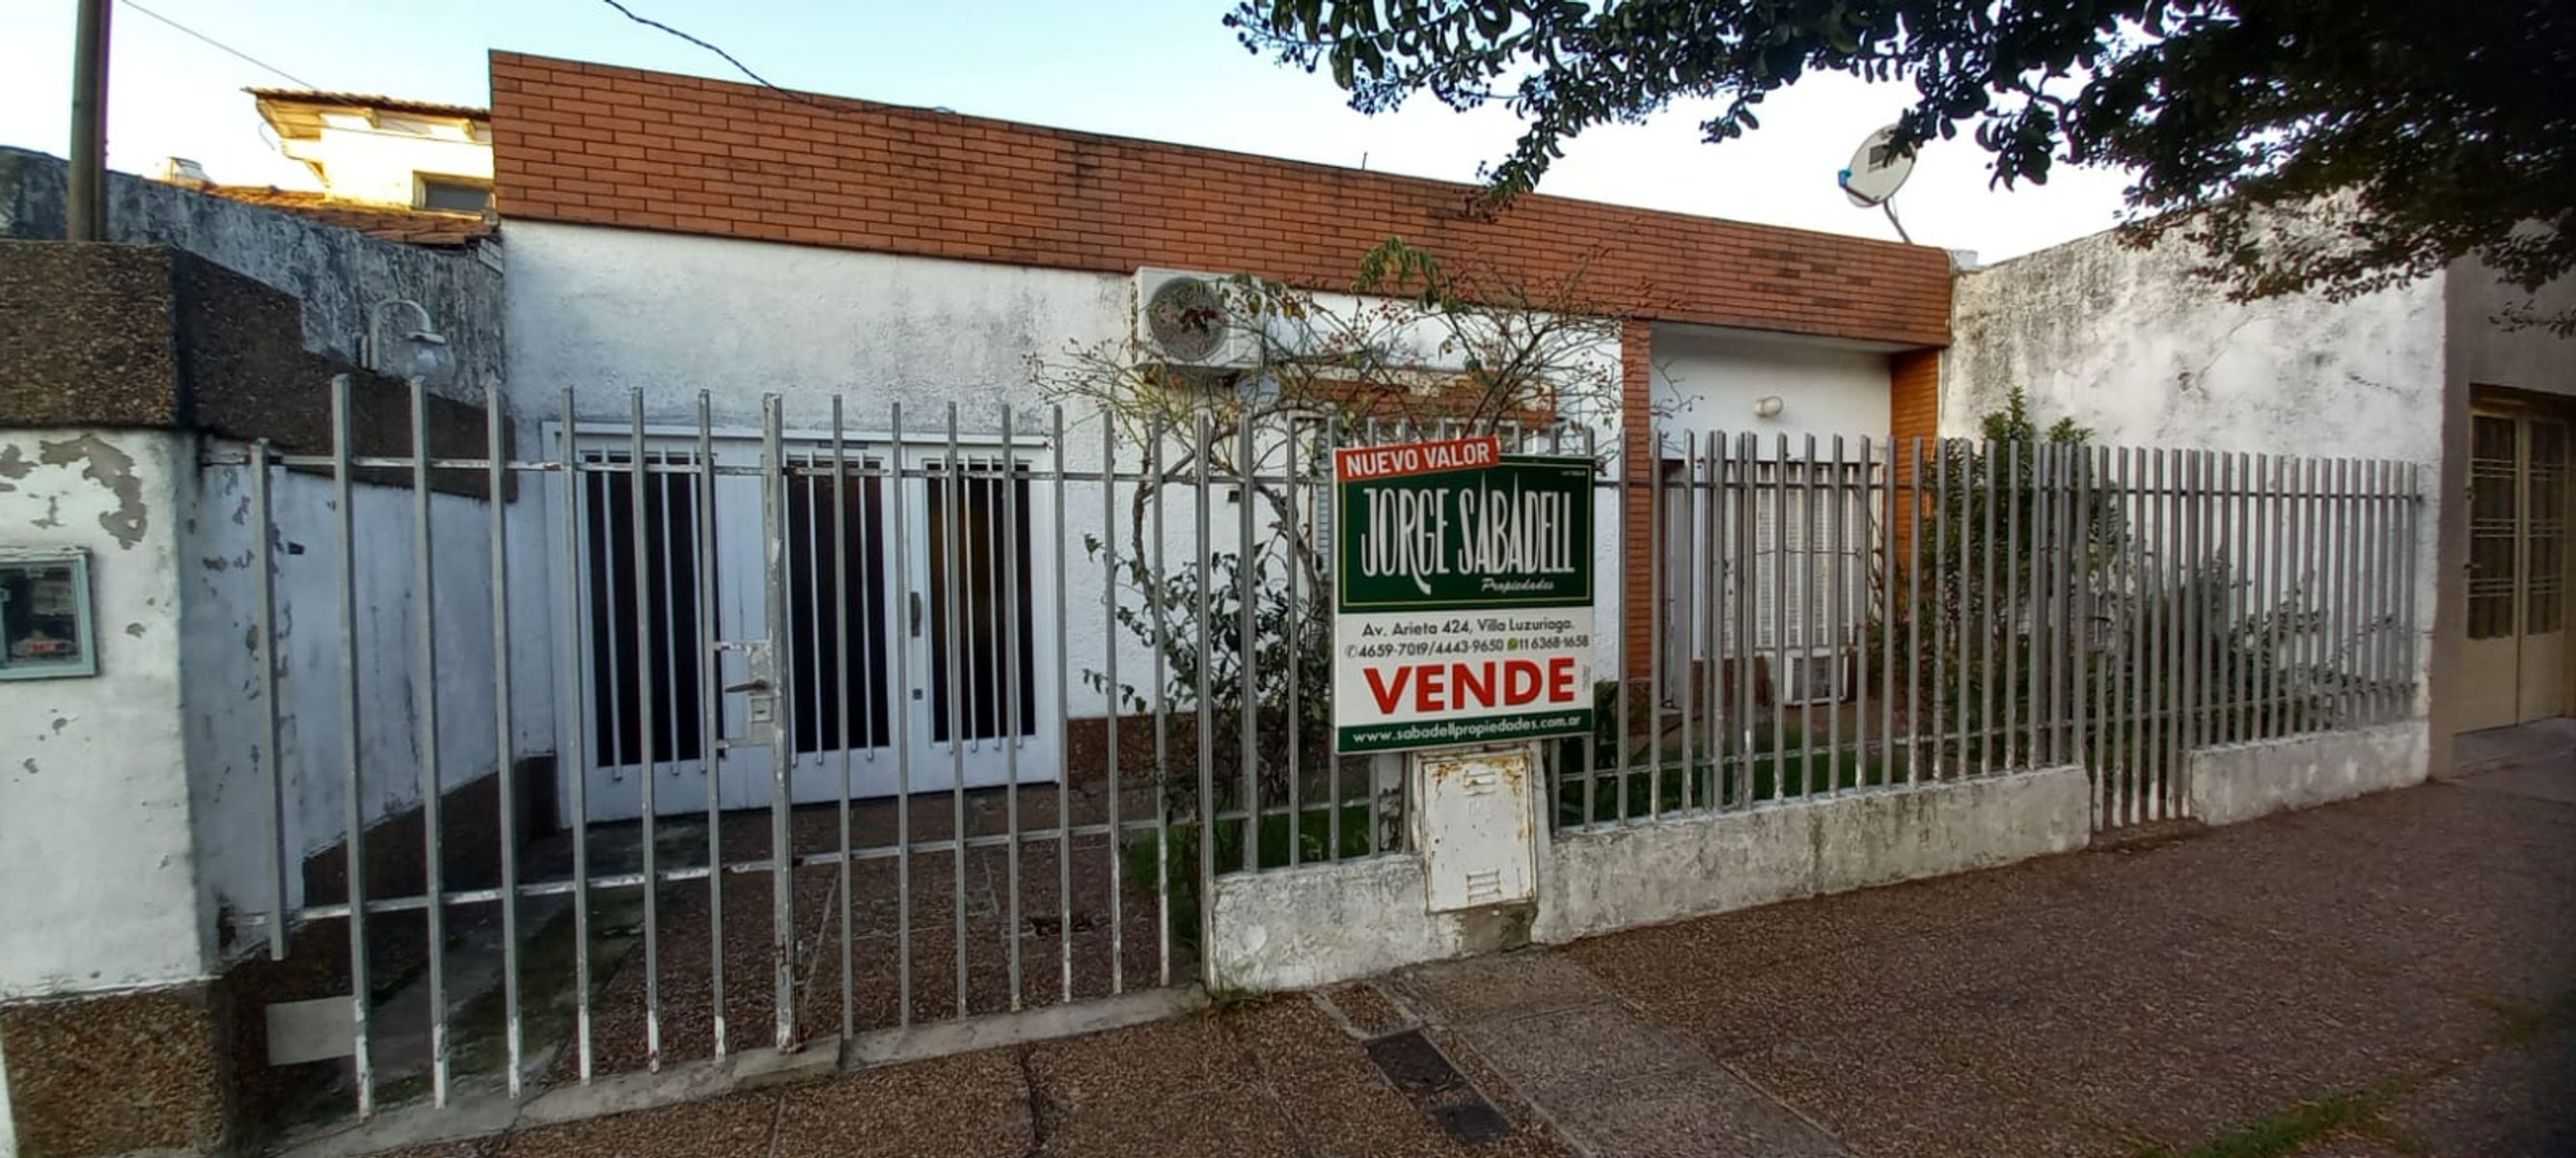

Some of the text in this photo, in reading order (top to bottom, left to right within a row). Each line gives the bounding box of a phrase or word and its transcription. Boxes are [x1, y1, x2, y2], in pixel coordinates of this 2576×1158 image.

[1345, 442, 1491, 478] NUEVO VALOR
[1361, 471, 1575, 595] JORGE SABADELL
[1481, 576, 1555, 593] Propiedades
[1361, 621, 1387, 637] Av.
[1391, 621, 1439, 636] Arieta
[1441, 619, 1473, 635] 424,
[1477, 618, 1506, 632] Villa
[1362, 656, 1575, 715] VENDE
[1353, 716, 1581, 743] www.sabadellpropiedades.com.ar
